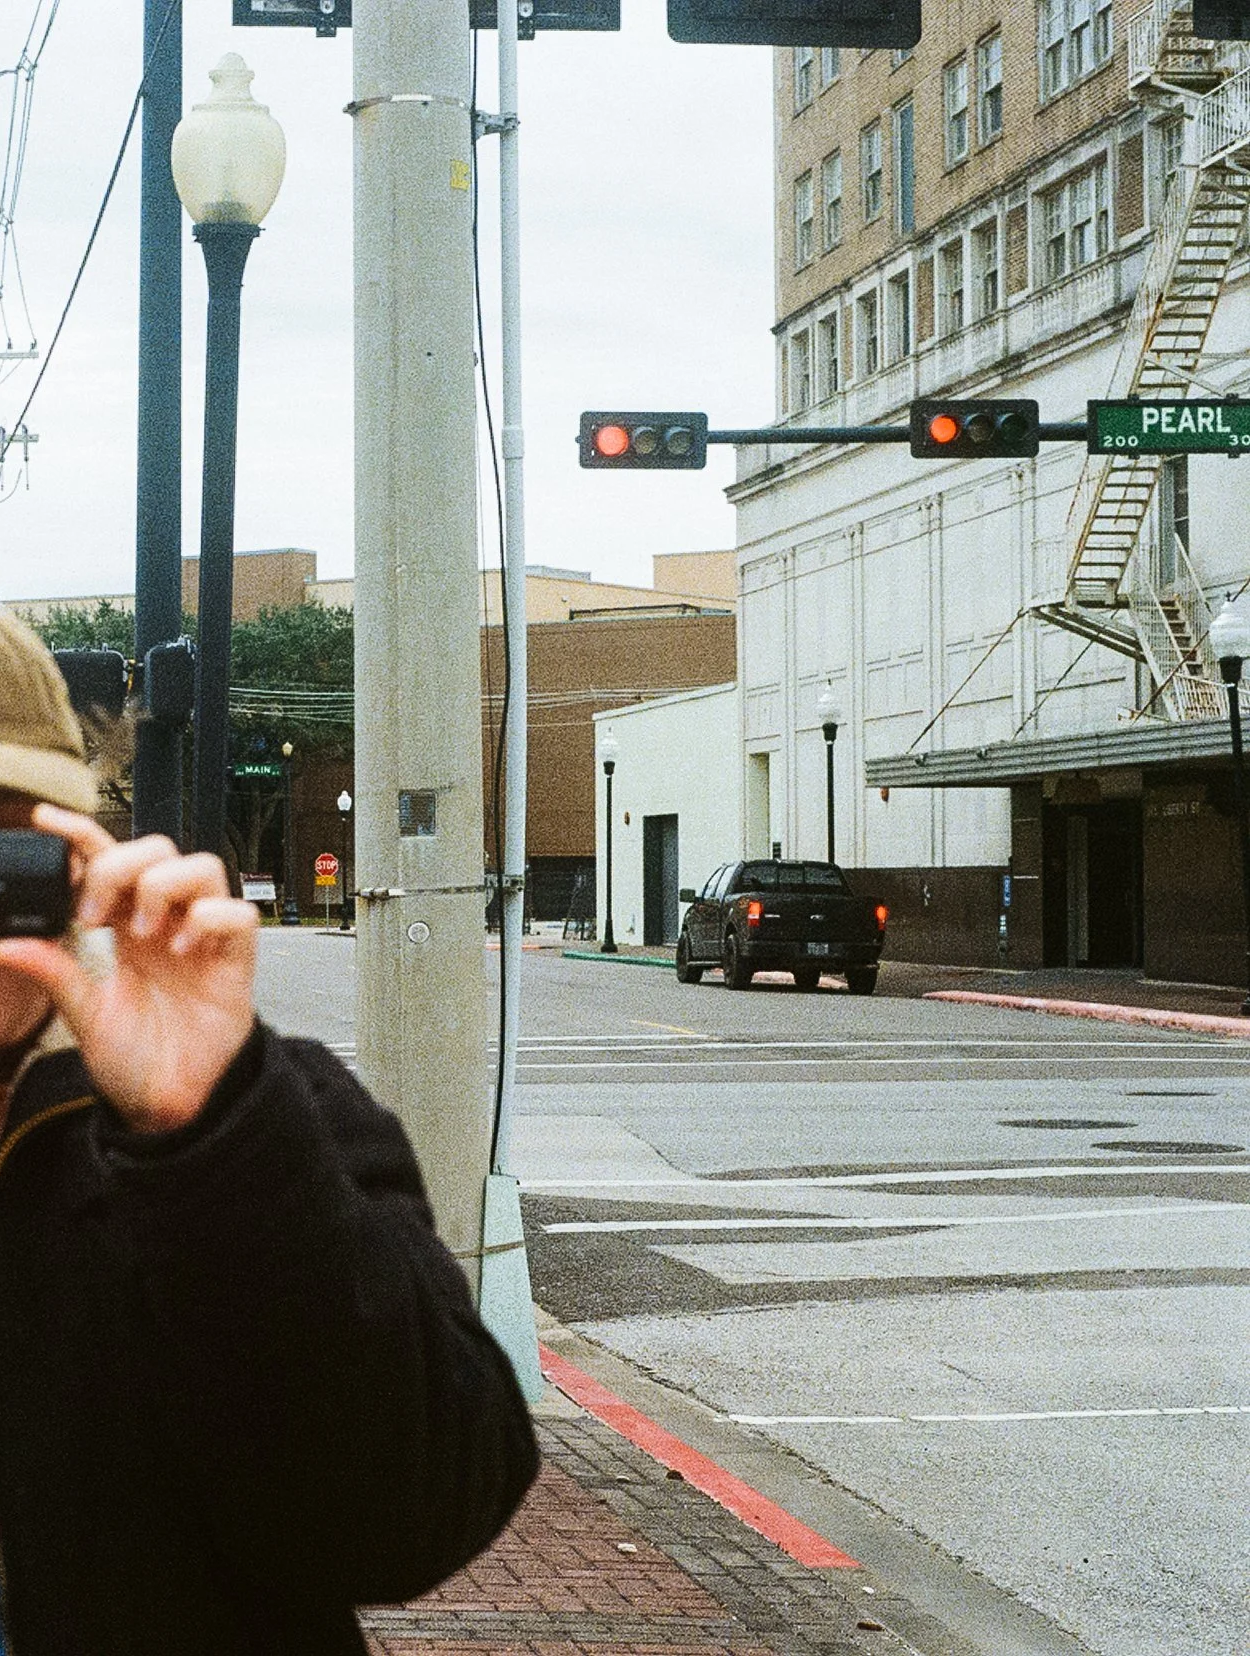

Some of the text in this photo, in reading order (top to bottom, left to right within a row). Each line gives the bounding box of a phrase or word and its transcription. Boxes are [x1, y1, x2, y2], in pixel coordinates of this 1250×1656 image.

[1142, 406, 1231, 433] PEARL
[1103, 435, 1139, 447] 200
[245, 766, 271, 774] MAIN
[316, 860, 337, 870] STOP
